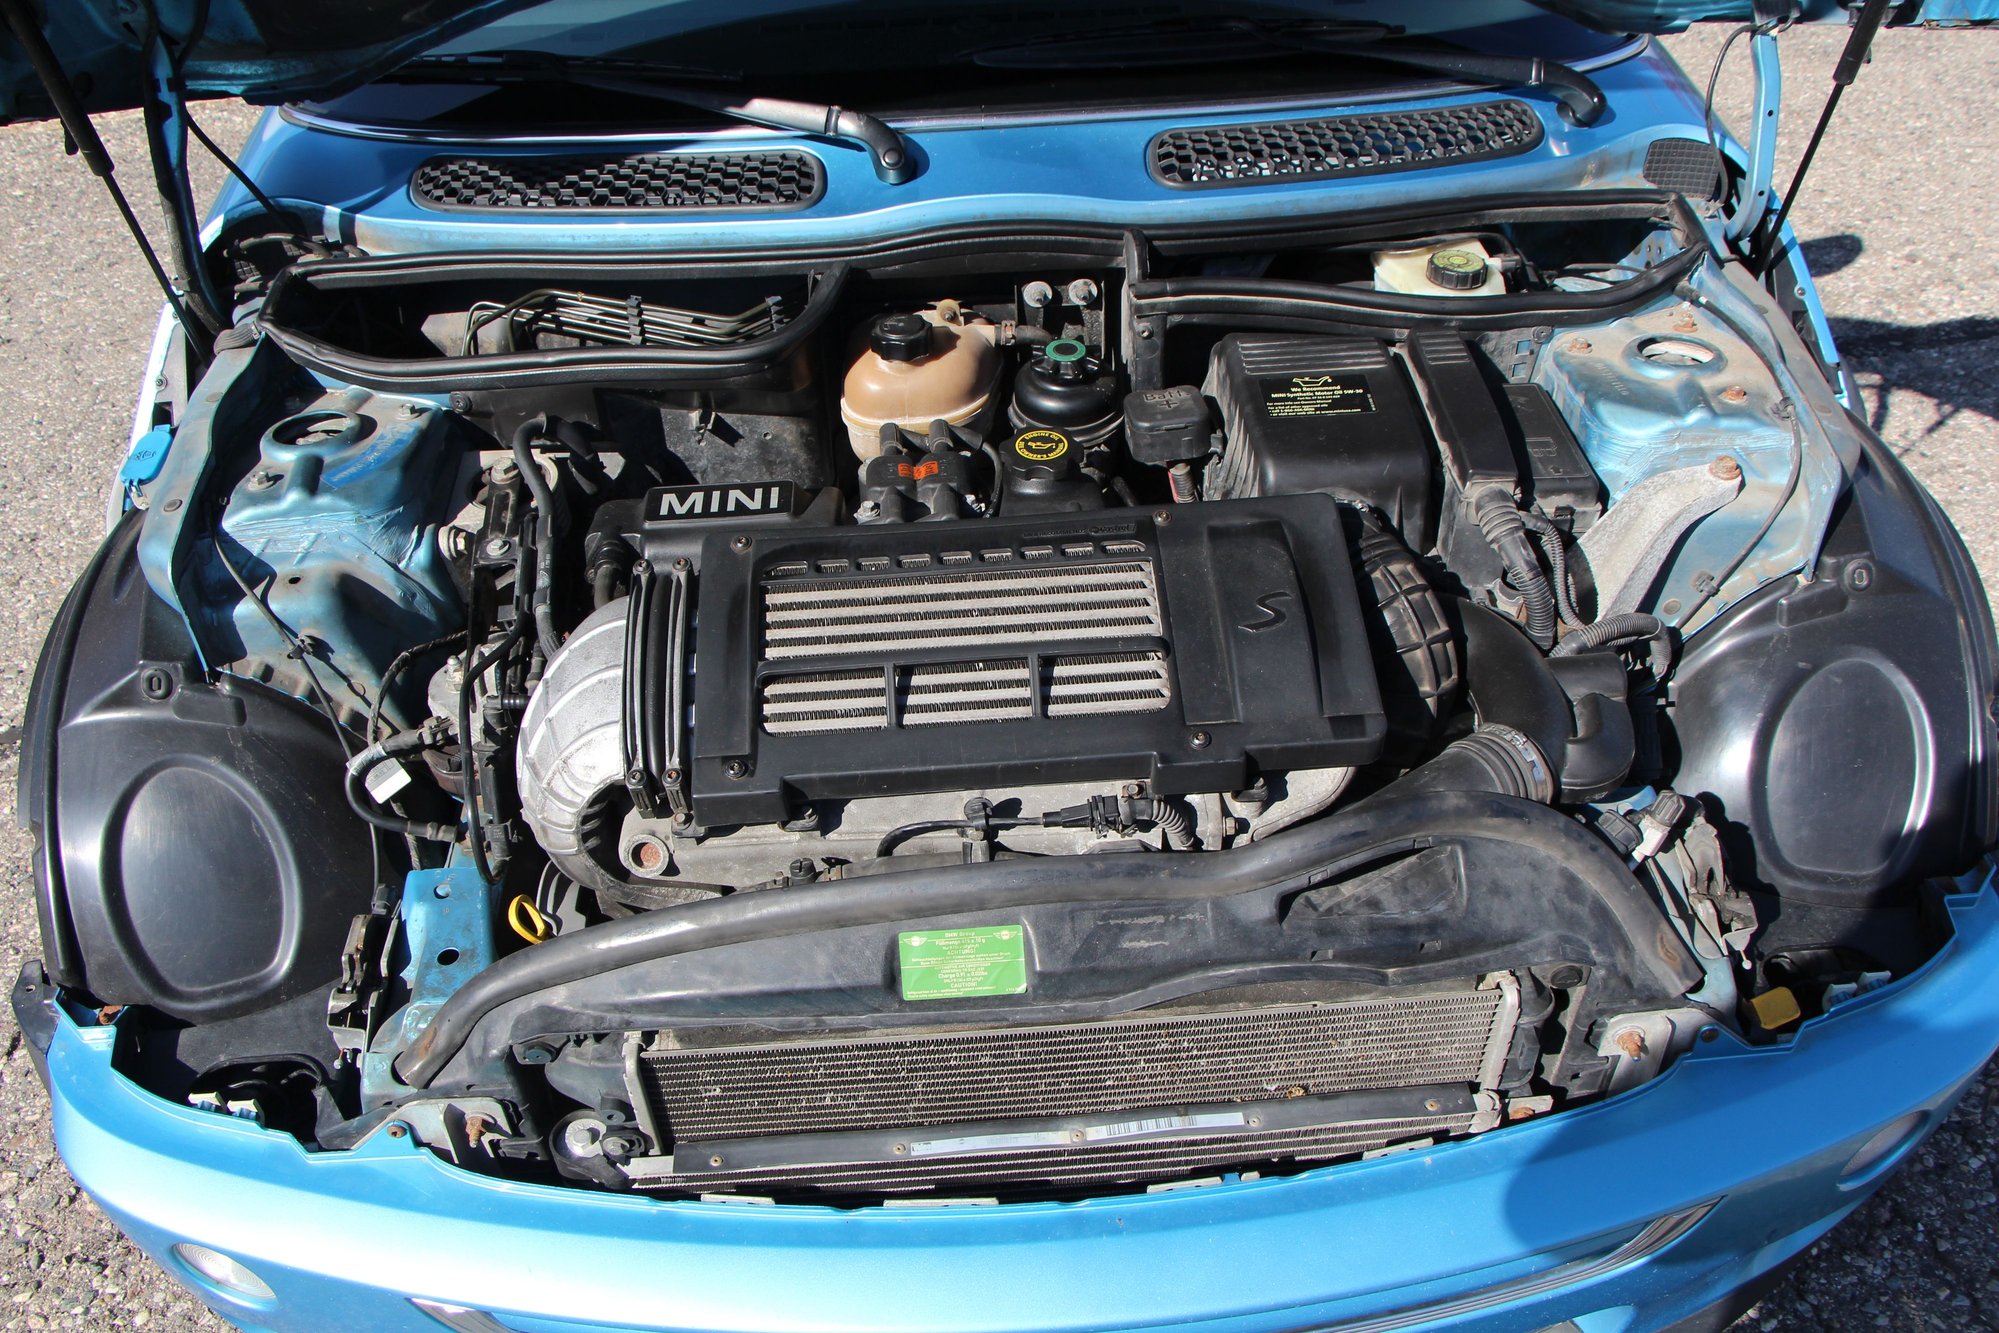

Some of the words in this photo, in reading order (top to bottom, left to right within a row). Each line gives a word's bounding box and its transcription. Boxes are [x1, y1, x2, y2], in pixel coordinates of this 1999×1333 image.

[1024, 432, 1050, 440] ENGINE
[660, 487, 779, 515] MINI
[1238, 590, 1293, 632] S
